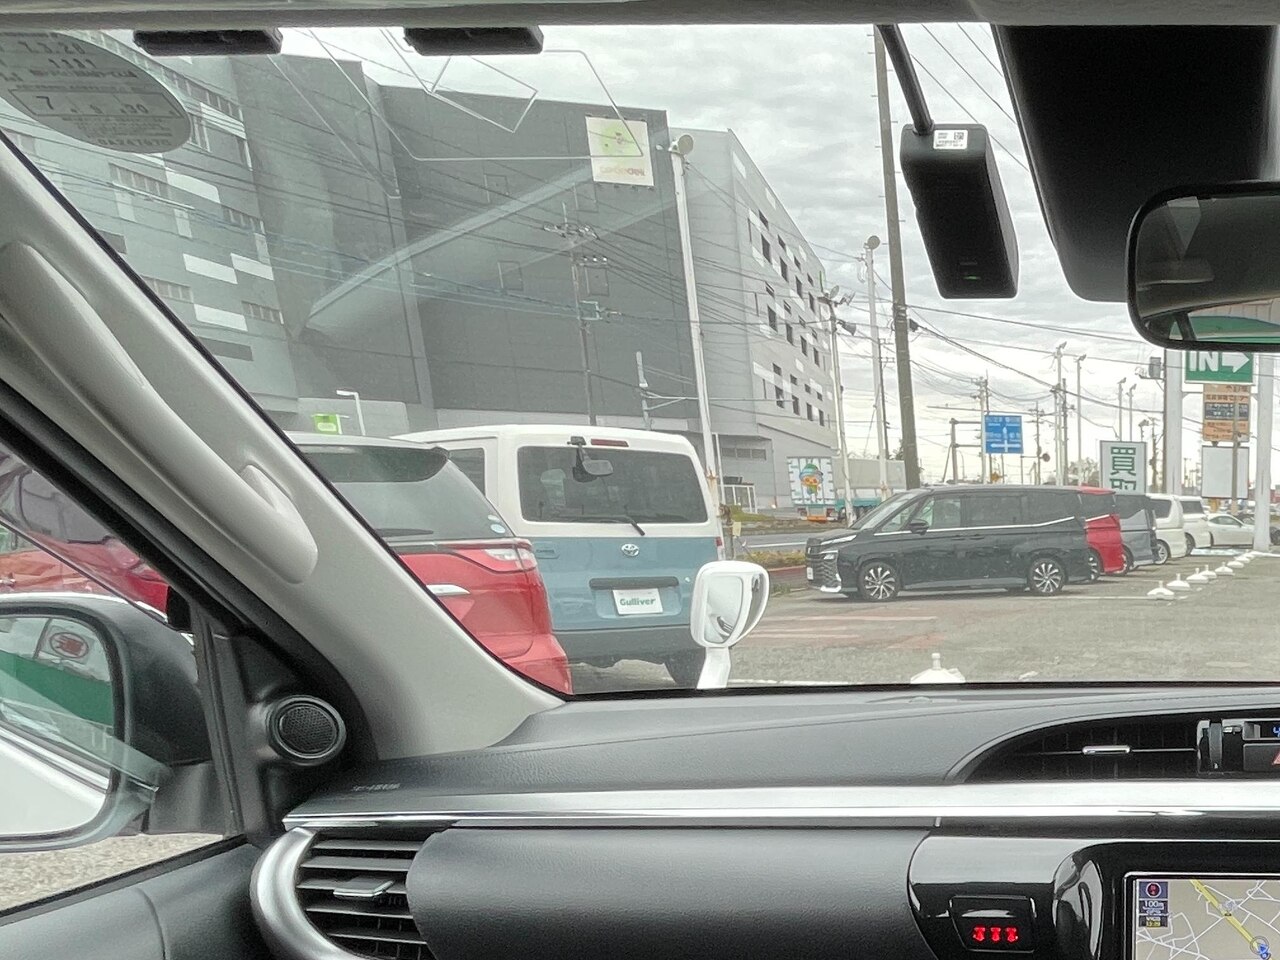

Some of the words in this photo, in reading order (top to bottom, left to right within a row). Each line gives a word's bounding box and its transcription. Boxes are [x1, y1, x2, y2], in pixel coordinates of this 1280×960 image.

[1189, 351, 1219, 372] IN
[619, 598, 656, 606] Gulliver
[1144, 900, 1165, 910] 100m
